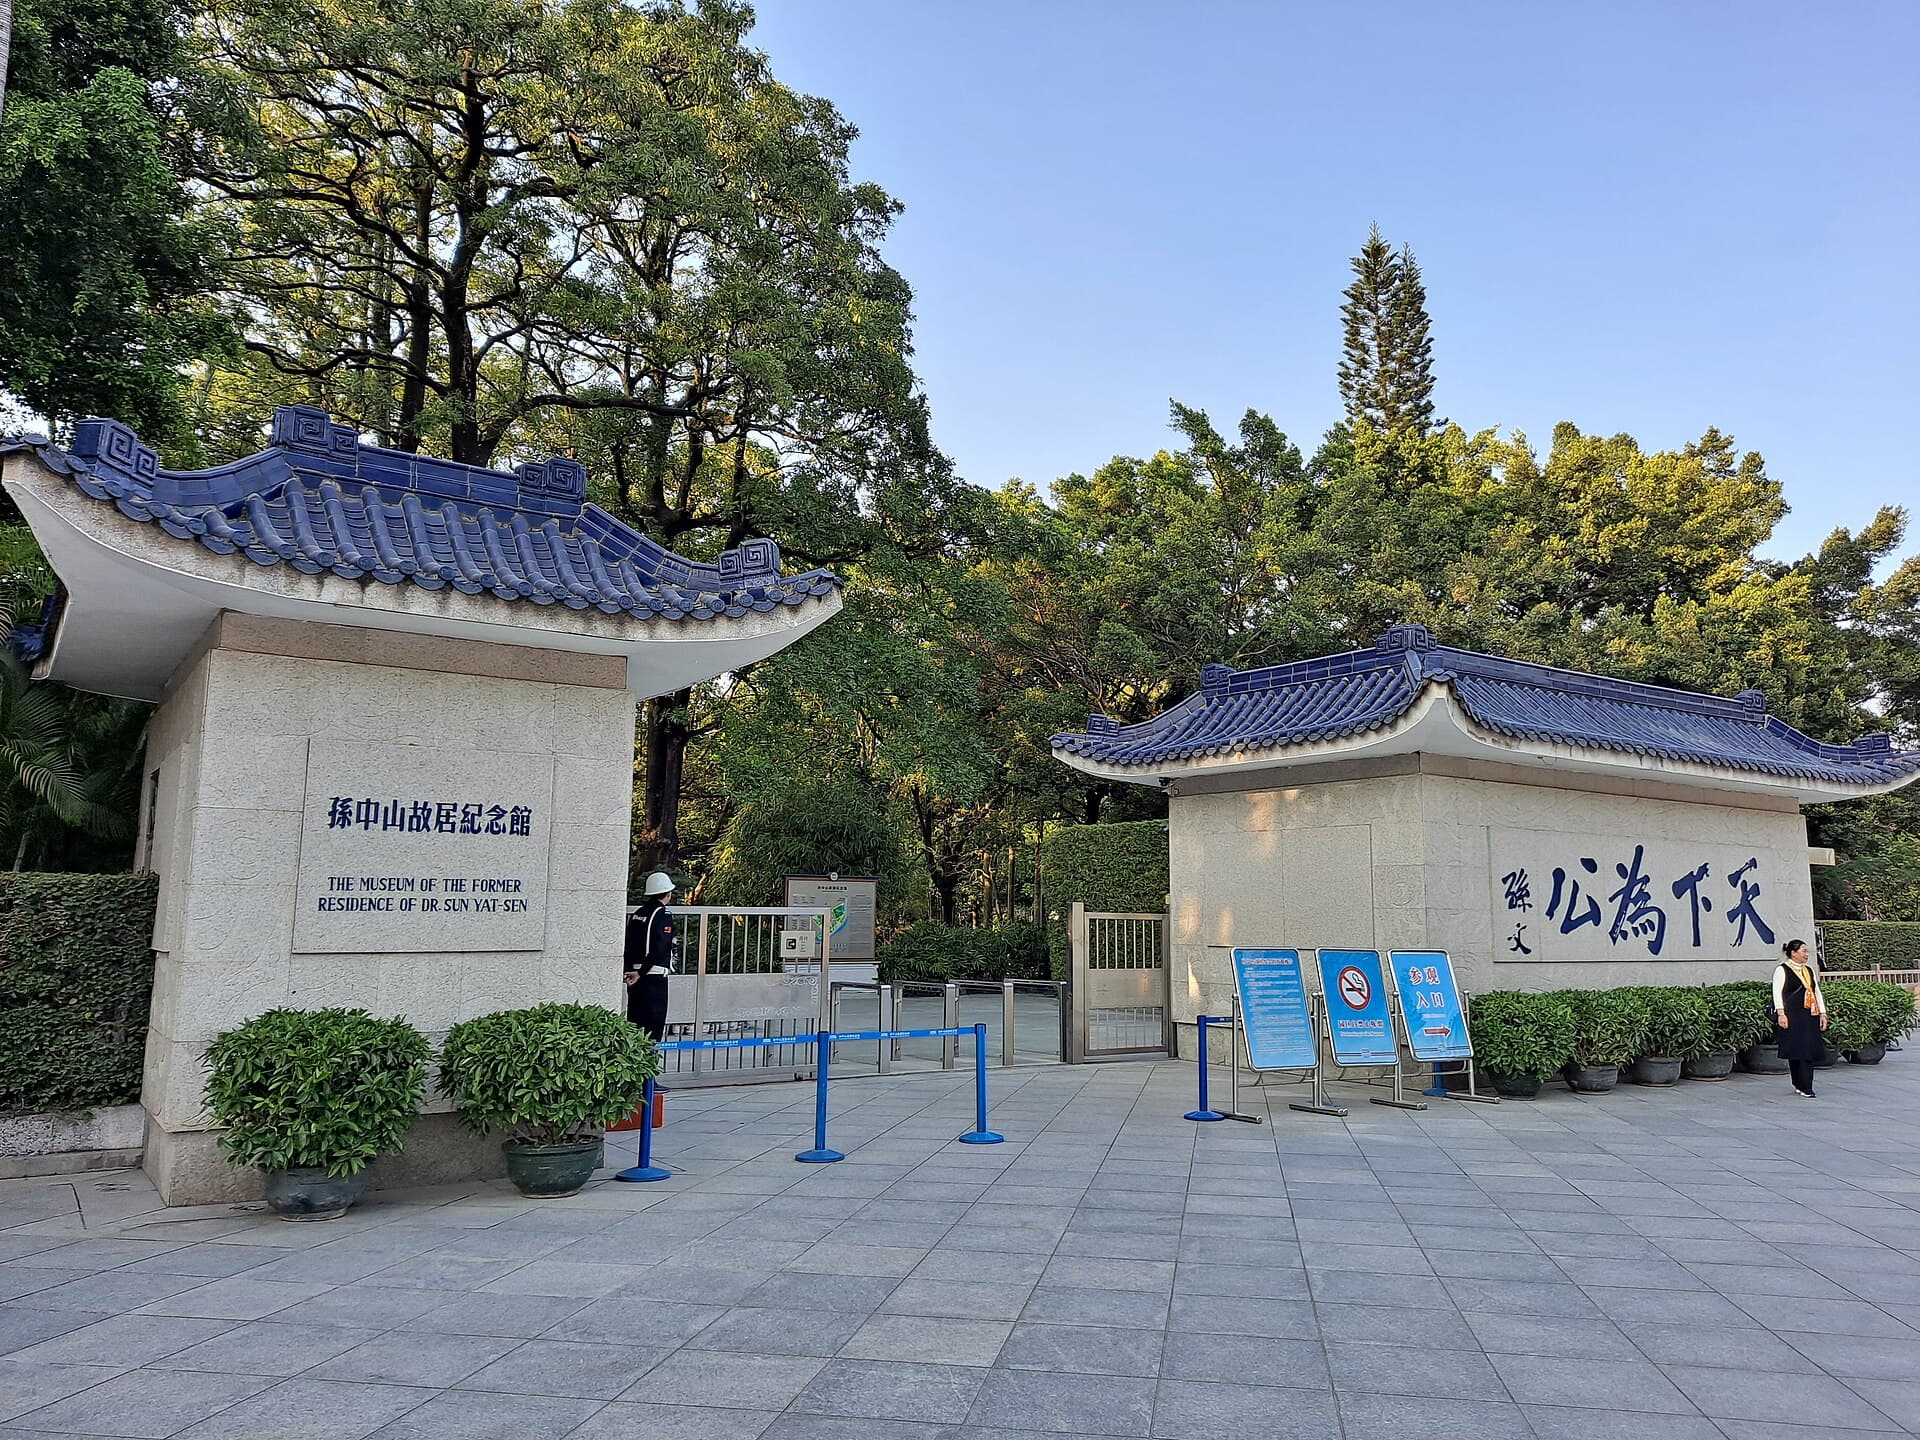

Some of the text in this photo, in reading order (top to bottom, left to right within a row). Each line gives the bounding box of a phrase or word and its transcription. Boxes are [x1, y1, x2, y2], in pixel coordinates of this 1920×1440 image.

[327, 796, 533, 837] 孫中山故居紀念館
[327, 876, 522, 893] THE MUSEUM OF THE FORMER
[317, 896, 394, 912] RESIDENCE
[399, 897, 418, 912] OF
[443, 898, 471, 913] SUN
[473, 898, 528, 913] YAT-SEN
[1416, 992, 1444, 1009] 入口
